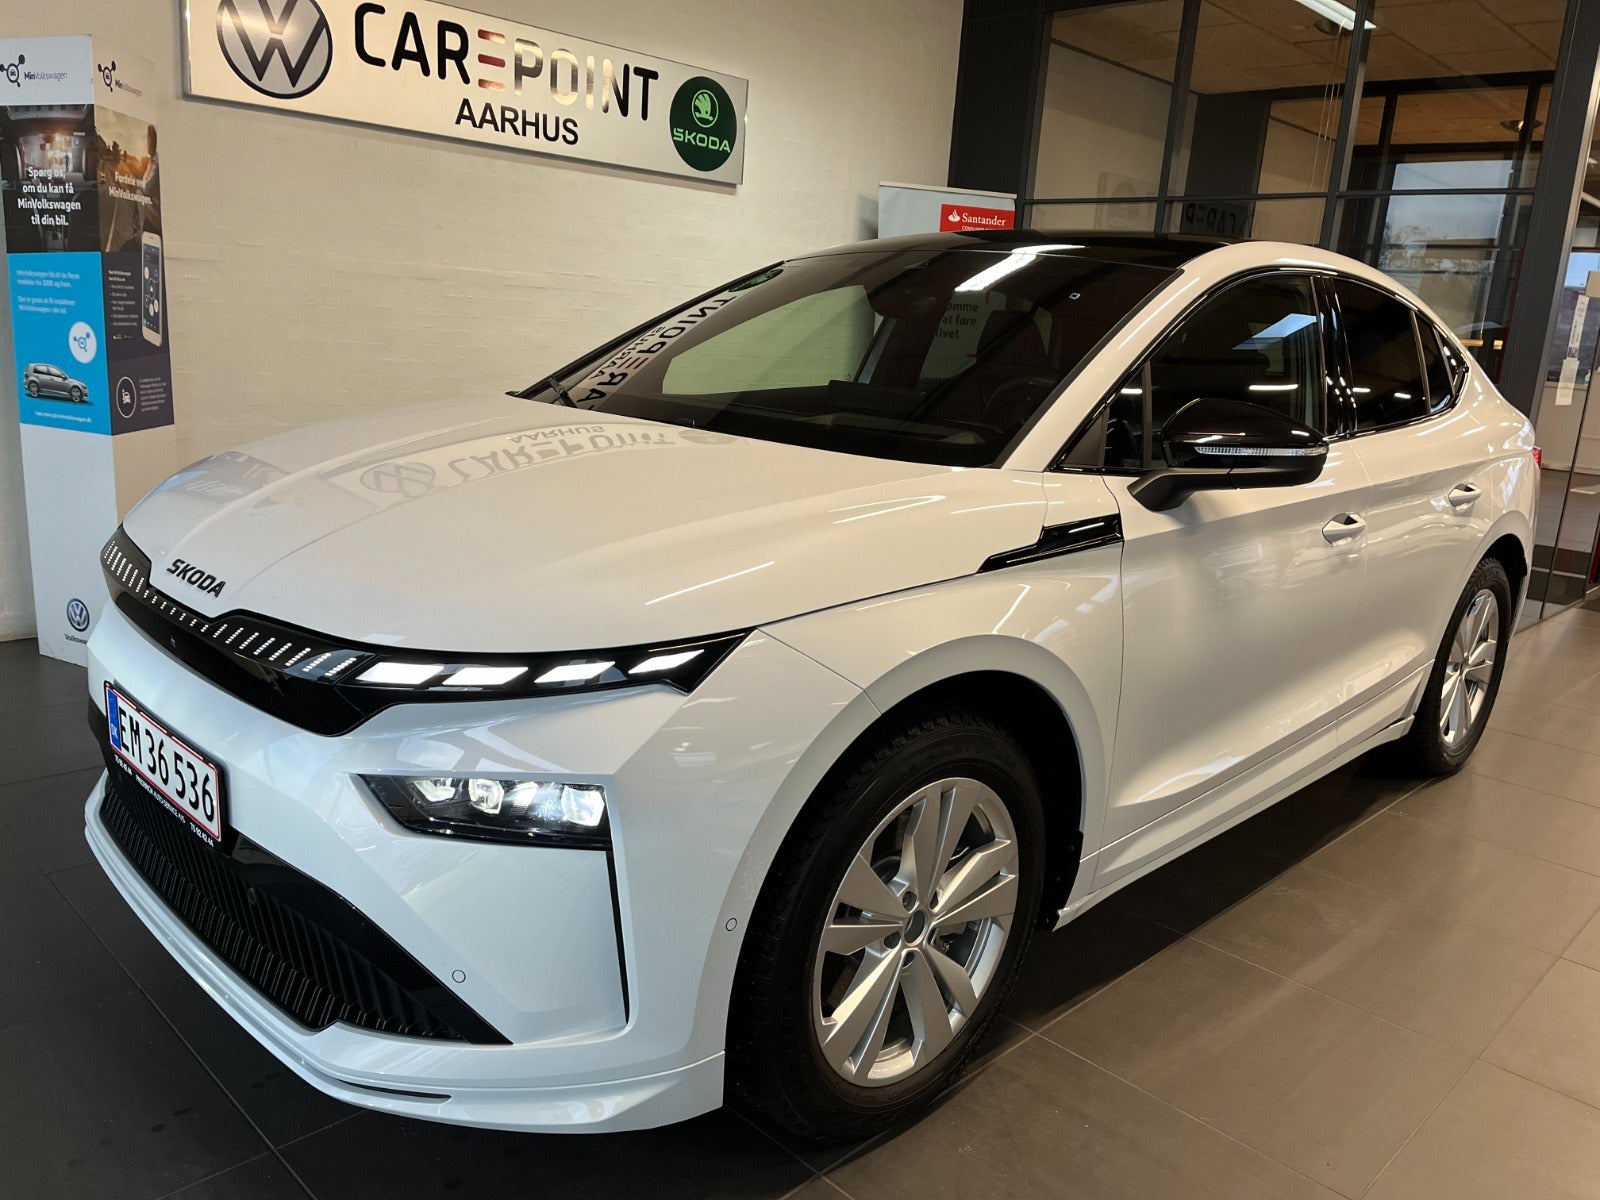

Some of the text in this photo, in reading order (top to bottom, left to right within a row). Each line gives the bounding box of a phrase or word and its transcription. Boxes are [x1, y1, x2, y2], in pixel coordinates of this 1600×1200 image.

[354, 2, 660, 122] CAREPOINT
[455, 98, 579, 146] AARHUS
[22, 181, 75, 194] om du kan få
[17, 197, 82, 213] MinVolkswagen
[961, 212, 1007, 226] Santander
[30, 213, 69, 226] til din bil.
[166, 558, 227, 598] SKODA
[118, 705, 143, 765] EM
[144, 728, 169, 786] 36
[173, 749, 215, 823] 536
